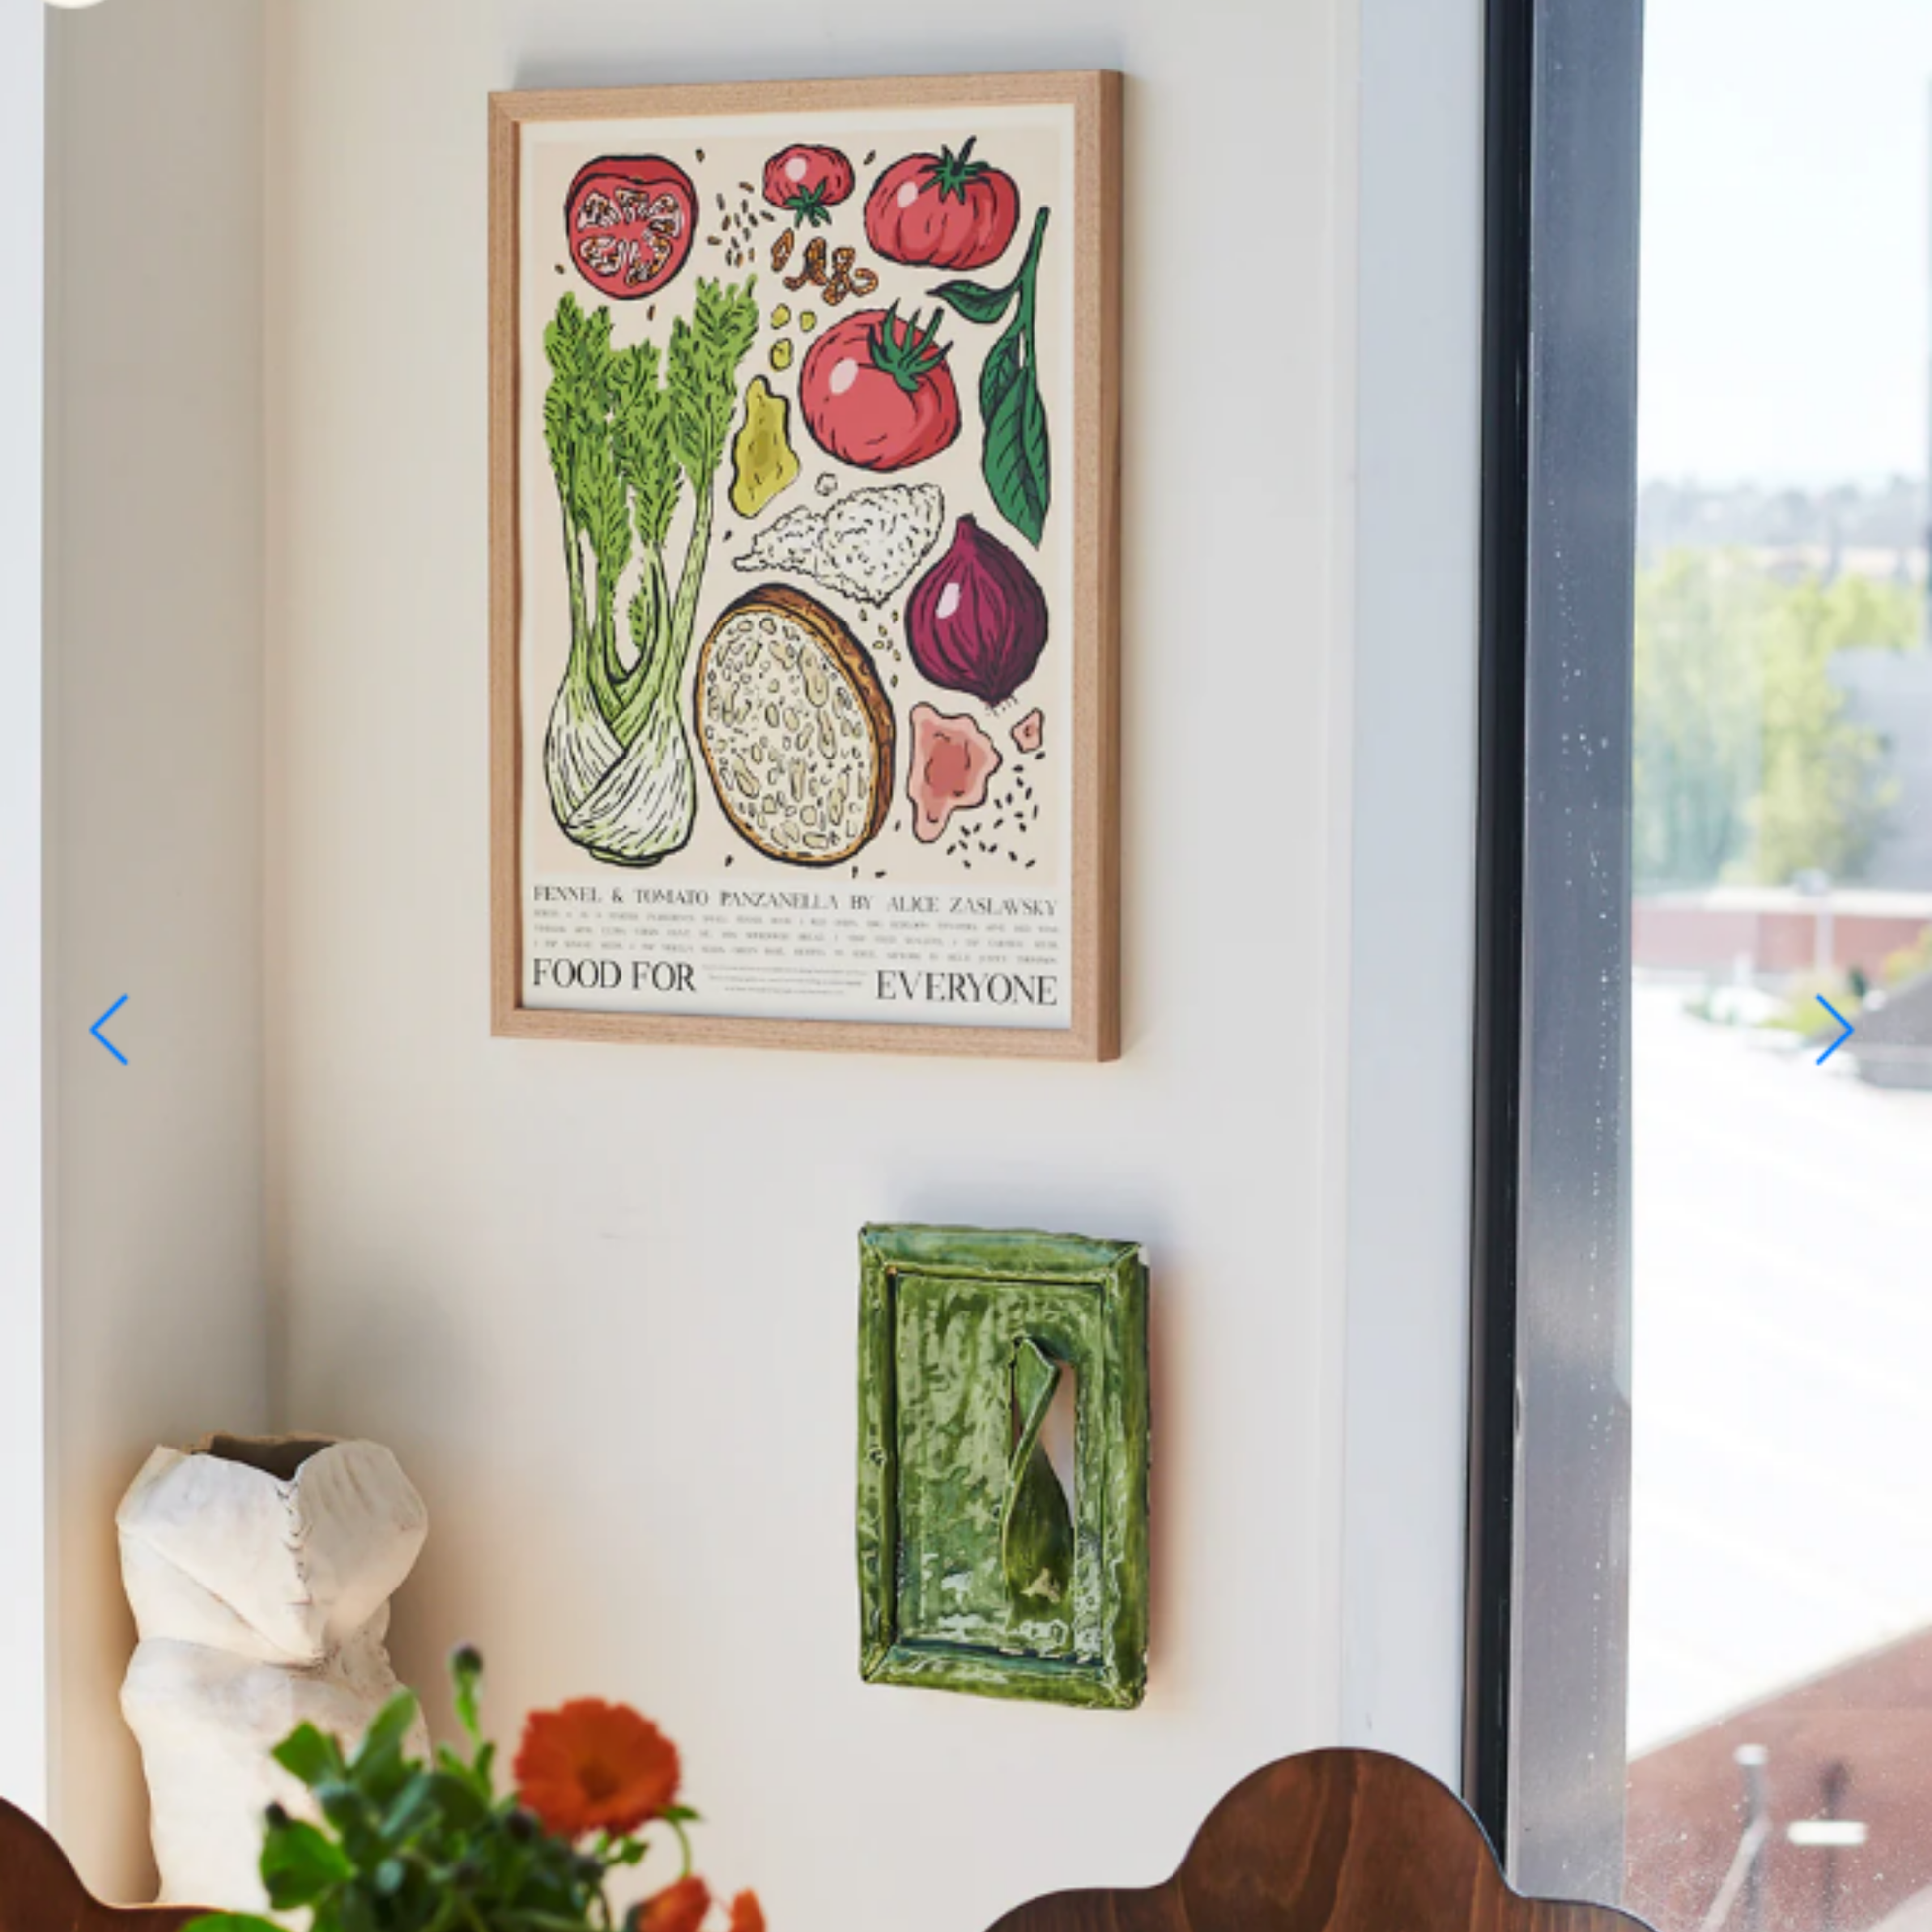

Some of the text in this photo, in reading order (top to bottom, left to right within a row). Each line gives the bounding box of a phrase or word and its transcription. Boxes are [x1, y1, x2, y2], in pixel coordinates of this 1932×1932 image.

[533, 886, 1058, 916] FENNEL & TOMATO PANZANELLA BY ALICE ZASLAVSKY
[532, 958, 621, 989] FOOD
[631, 961, 696, 992] FOR
[877, 970, 1058, 1006] EVERYONE
